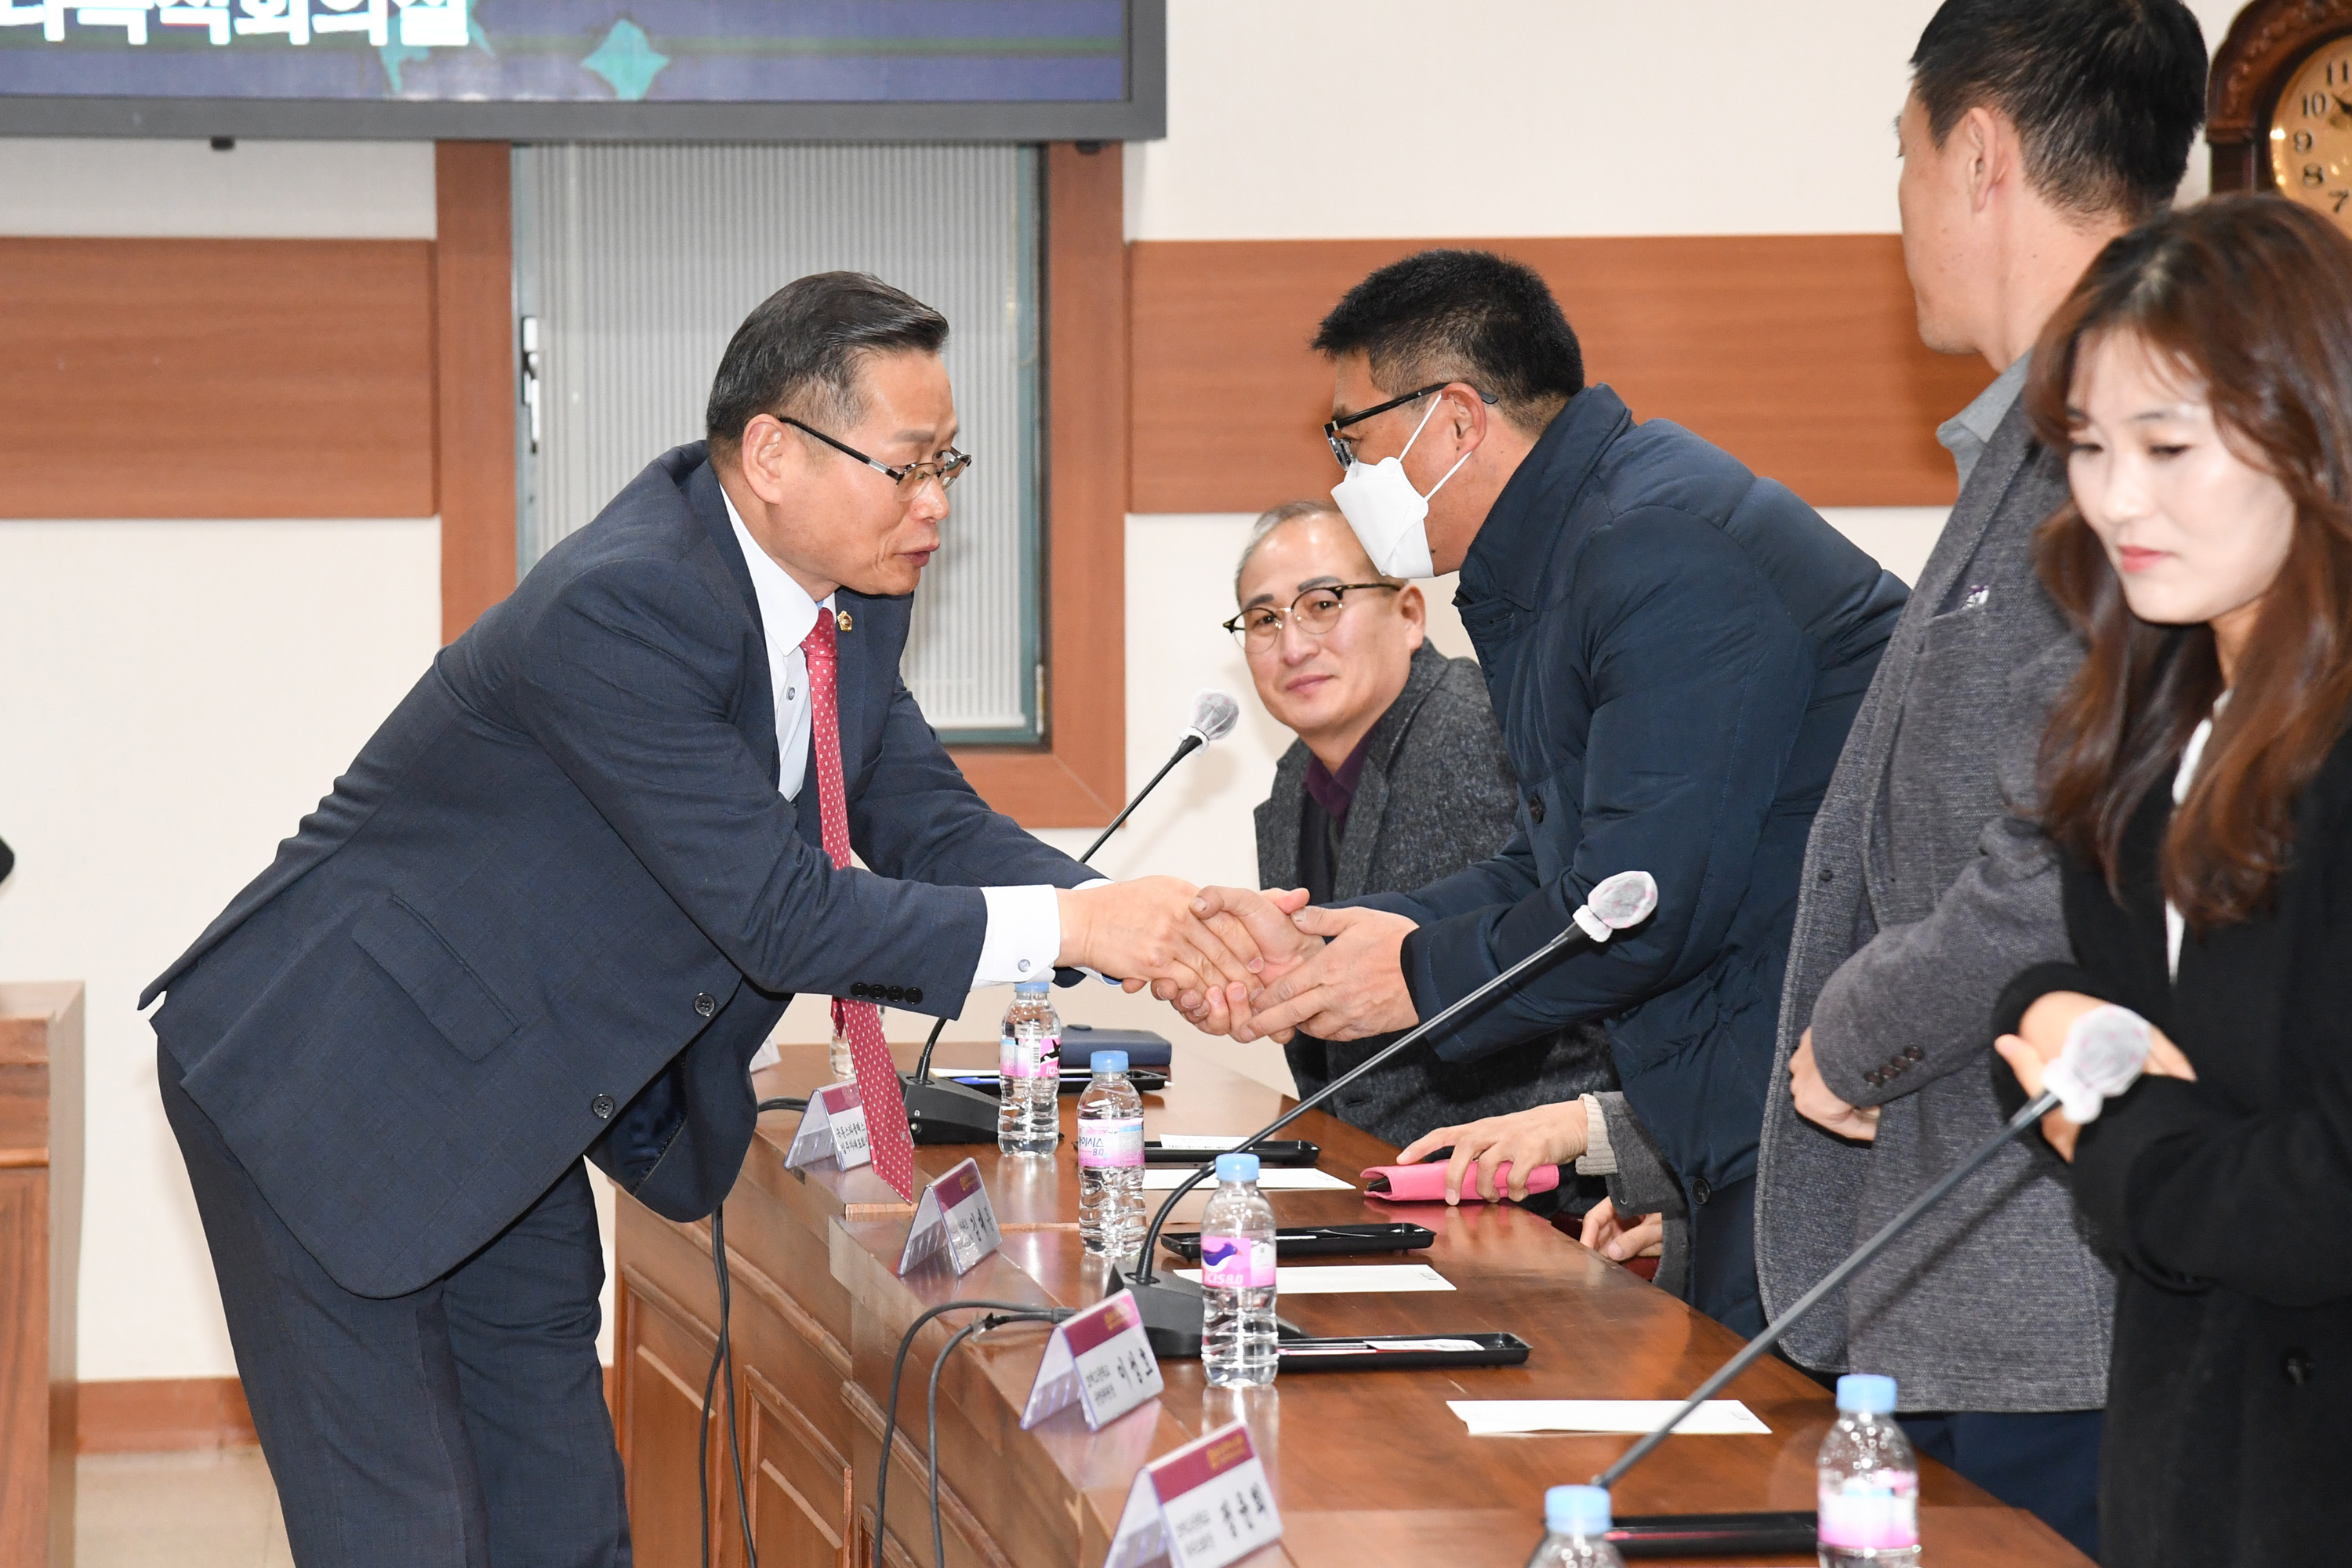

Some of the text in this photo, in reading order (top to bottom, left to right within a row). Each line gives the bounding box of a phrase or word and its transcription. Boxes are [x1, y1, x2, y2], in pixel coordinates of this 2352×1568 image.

[2327, 60, 2349, 85] 11
[2303, 93, 2326, 117] 10
[2294, 131, 2312, 153] 9
[2303, 165, 2323, 186] 8
[2328, 191, 2349, 212] 7
